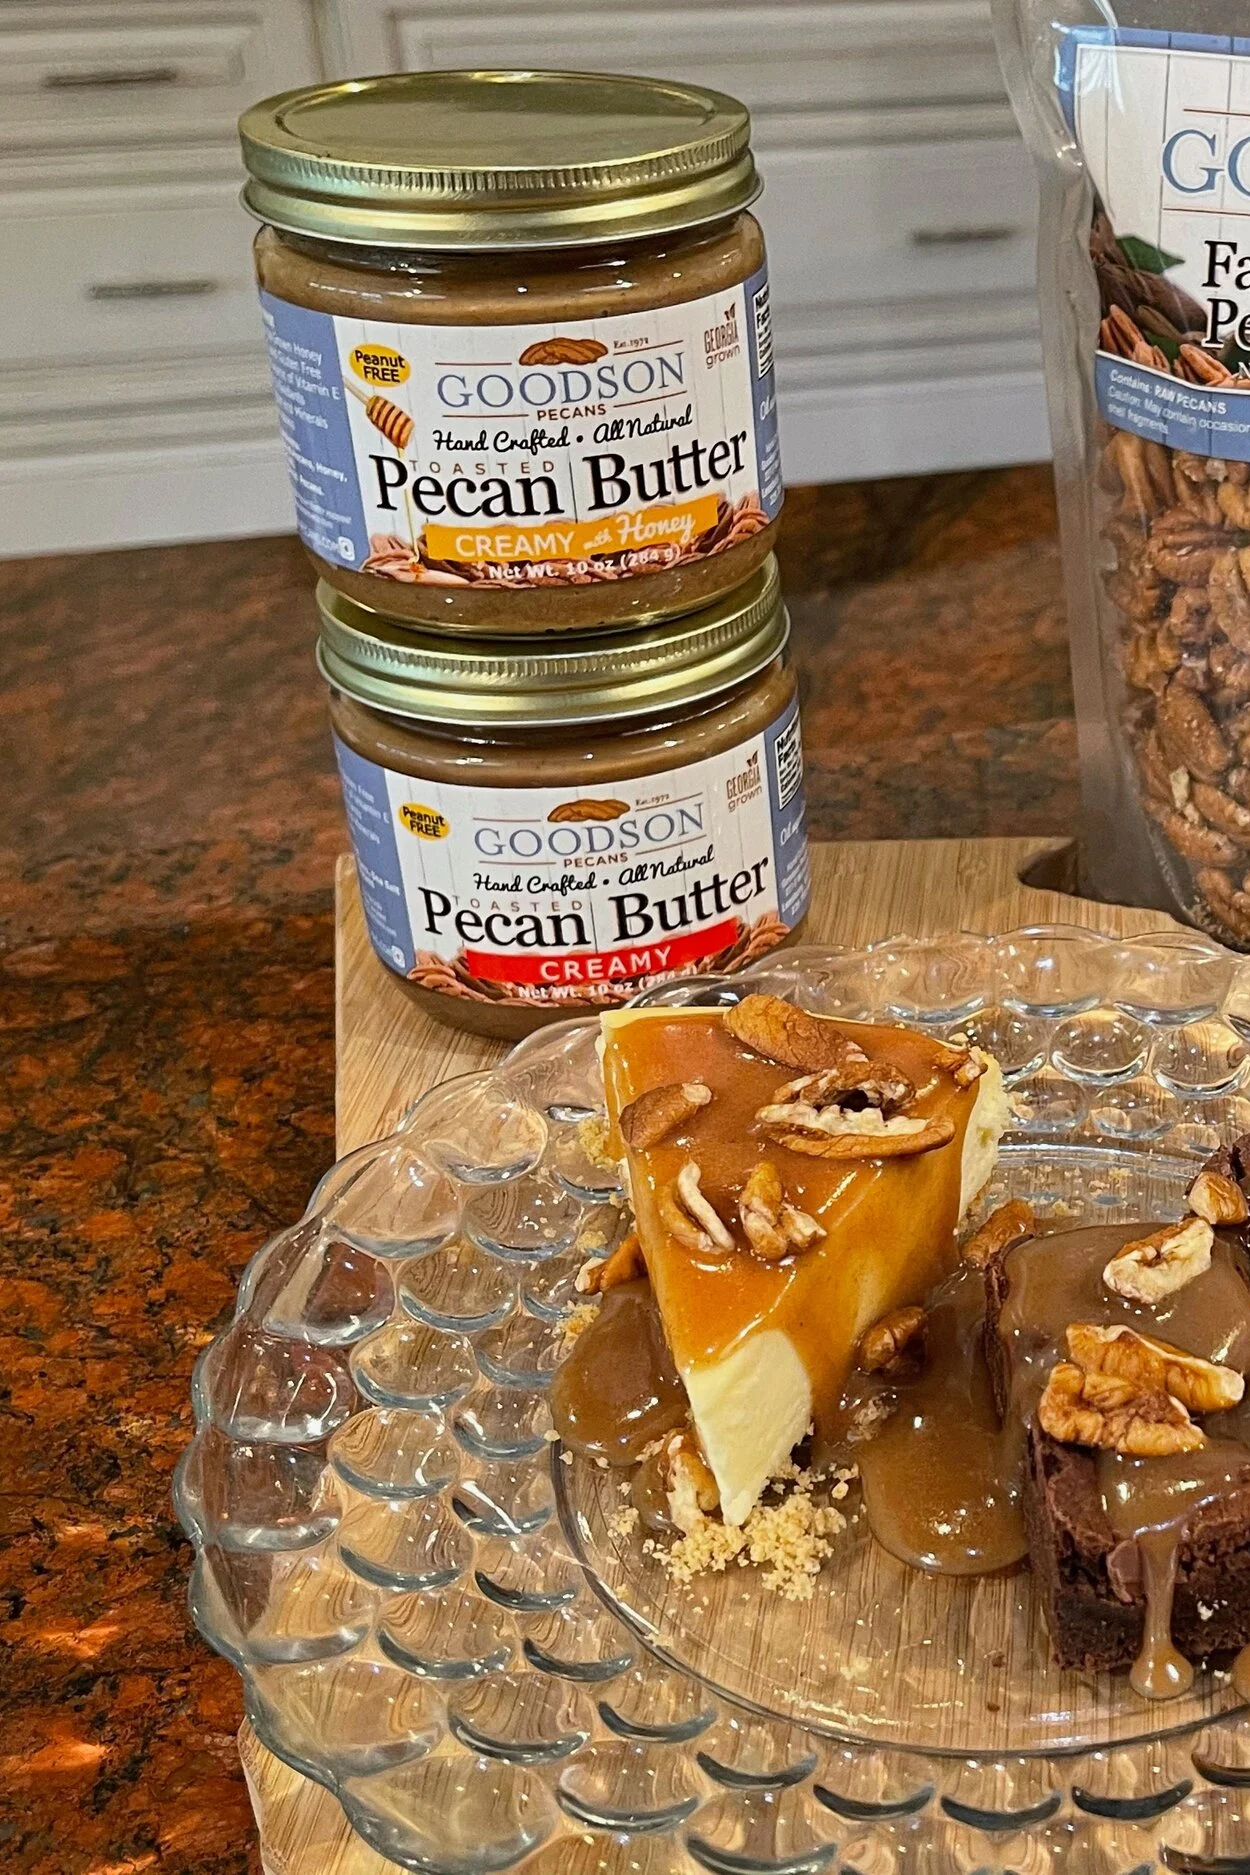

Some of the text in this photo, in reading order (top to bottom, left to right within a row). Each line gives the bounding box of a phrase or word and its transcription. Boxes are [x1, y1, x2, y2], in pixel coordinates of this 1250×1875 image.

[703, 319, 740, 354] GEORGIA
[355, 350, 406, 369] Peanut
[705, 344, 742, 370] grown
[363, 366, 401, 384] FREE
[437, 351, 685, 408] GOODSON
[536, 403, 607, 422] PECANS
[1176, 391, 1227, 415] PECANS
[432, 403, 693, 456] Hand Crafted All Natural
[367, 453, 566, 520] Pecan
[581, 430, 748, 513] Butter
[408, 459, 555, 476] TOASTED
[455, 530, 576, 560] CREAMY
[614, 512, 696, 548] Honey
[486, 564, 523, 580] Net
[526, 561, 561, 578] Wt.
[566, 561, 590, 576] 10
[594, 555, 618, 573] oz
[726, 766, 761, 799] GEORGIA
[728, 785, 763, 812] grown
[403, 805, 445, 826] Peanut
[409, 820, 442, 838] FREE
[474, 803, 704, 858] GOODSON
[473, 843, 715, 897] Hand Crafted All Natural
[563, 852, 629, 868] PECANS
[417, 886, 592, 948] Pecan
[607, 856, 769, 942] Butter
[453, 895, 583, 912] TOASTED
[539, 945, 672, 982] CREAMY
[518, 986, 549, 999] Net
[588, 982, 609, 997] 10
